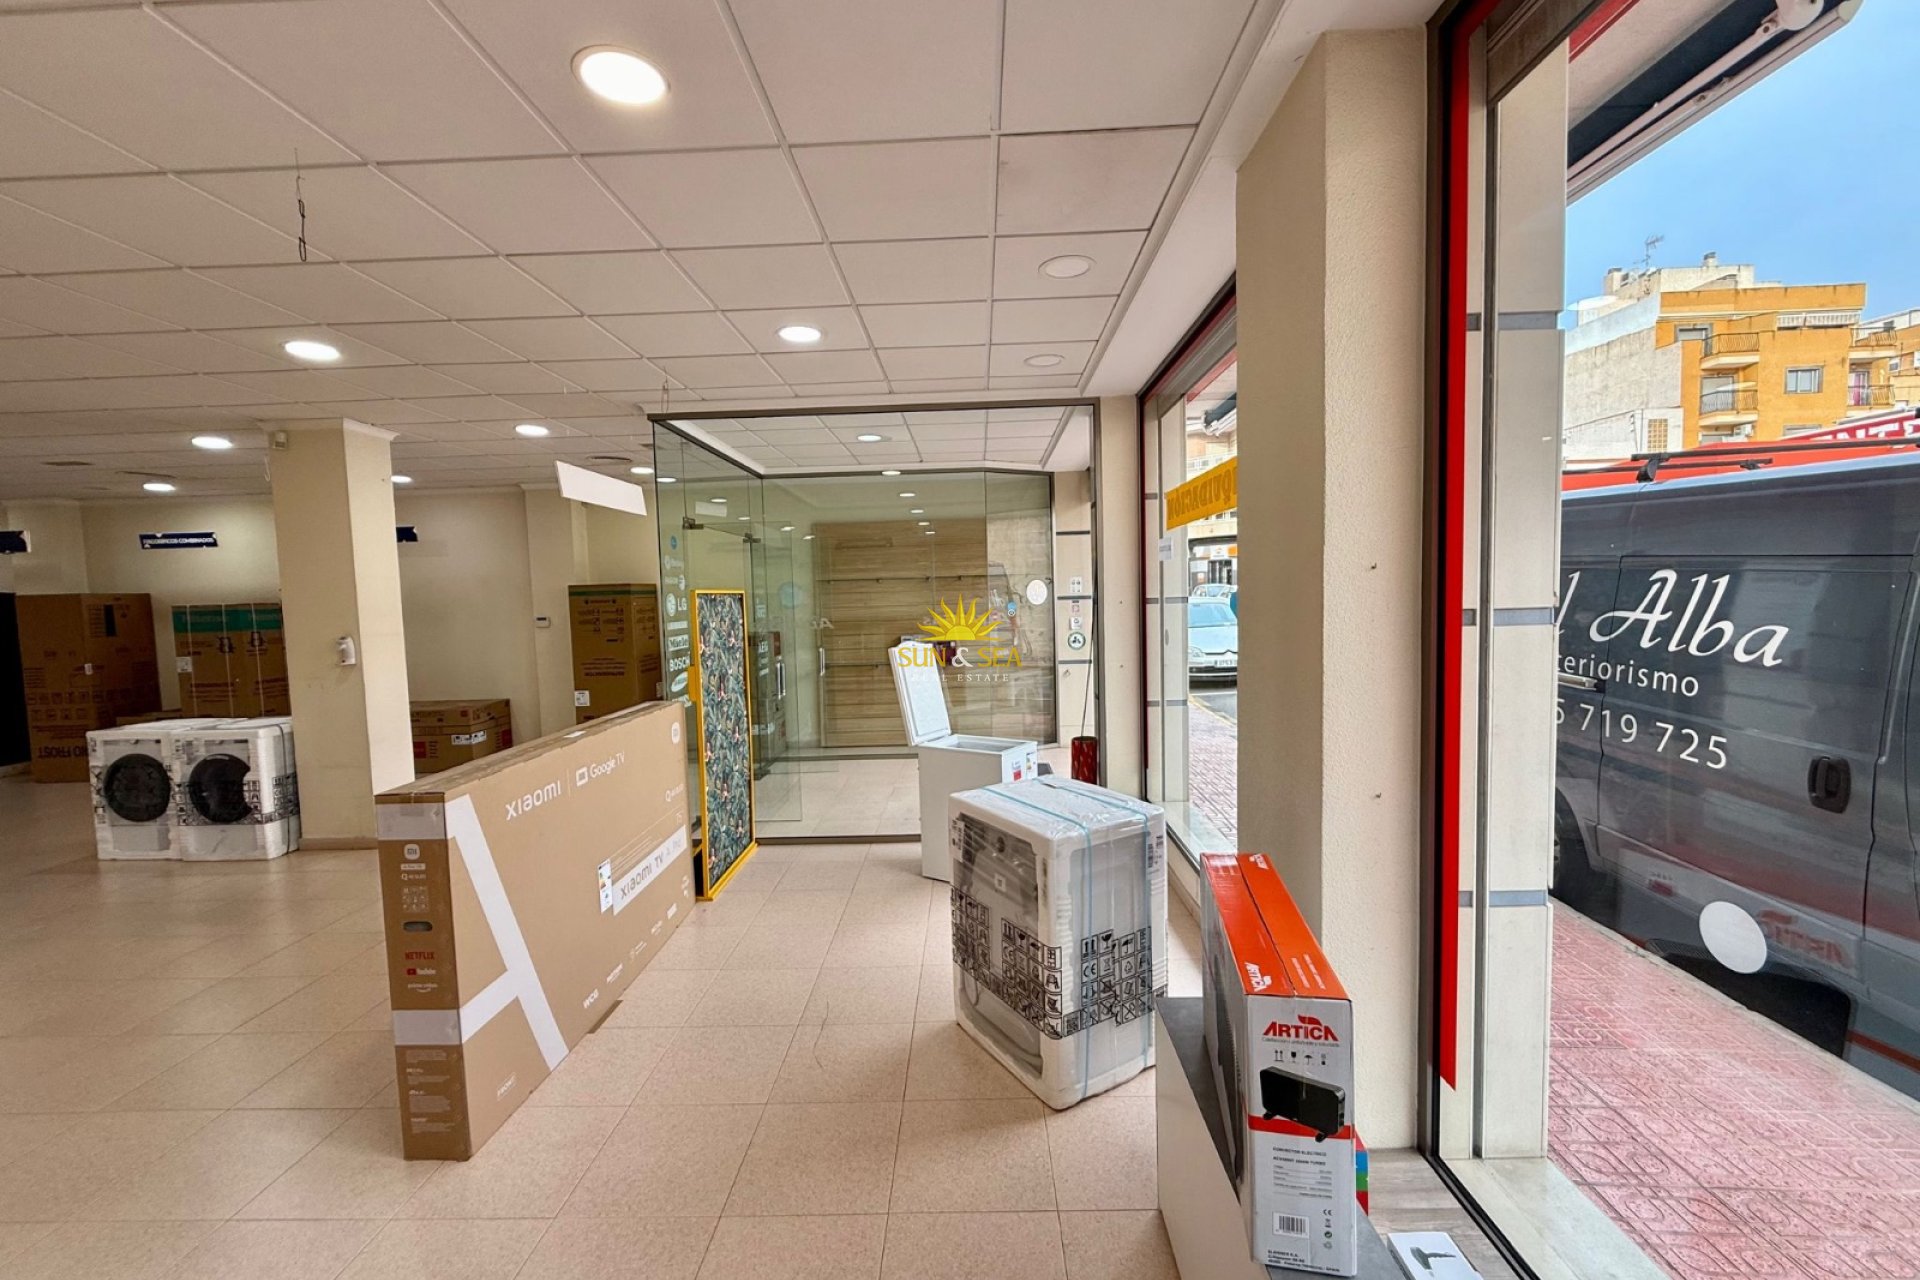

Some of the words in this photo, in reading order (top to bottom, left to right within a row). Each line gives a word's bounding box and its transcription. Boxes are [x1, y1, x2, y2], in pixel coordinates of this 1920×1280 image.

[1589, 568, 1789, 667] Alba
[1557, 653, 1699, 698] teriorismo
[1579, 703, 1638, 743] 719
[1655, 721, 1728, 770] 725
[590, 758, 617, 779] Google
[616, 751, 625, 768] TV
[654, 851, 665, 869] TV
[404, 951, 435, 960] NETFLIX
[1262, 1019, 1339, 1042] ARTICA
